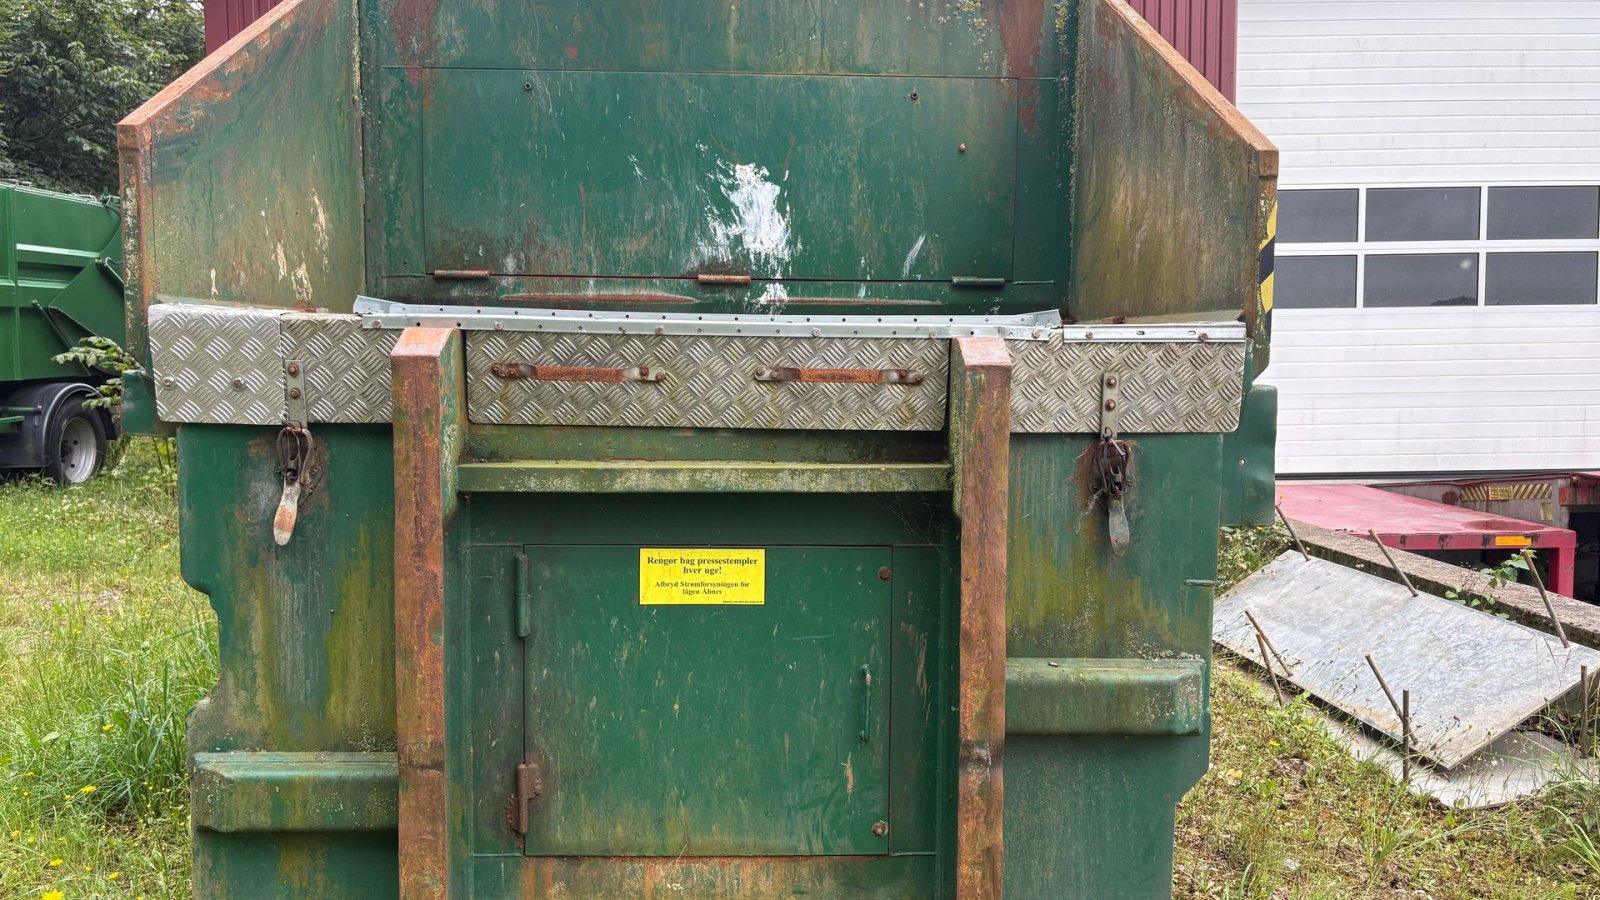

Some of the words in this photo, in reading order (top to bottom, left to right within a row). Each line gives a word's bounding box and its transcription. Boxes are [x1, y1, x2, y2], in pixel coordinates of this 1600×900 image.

[680, 557, 694, 565] bag
[697, 557, 758, 566] pressestempler
[704, 566, 722, 575] uge!
